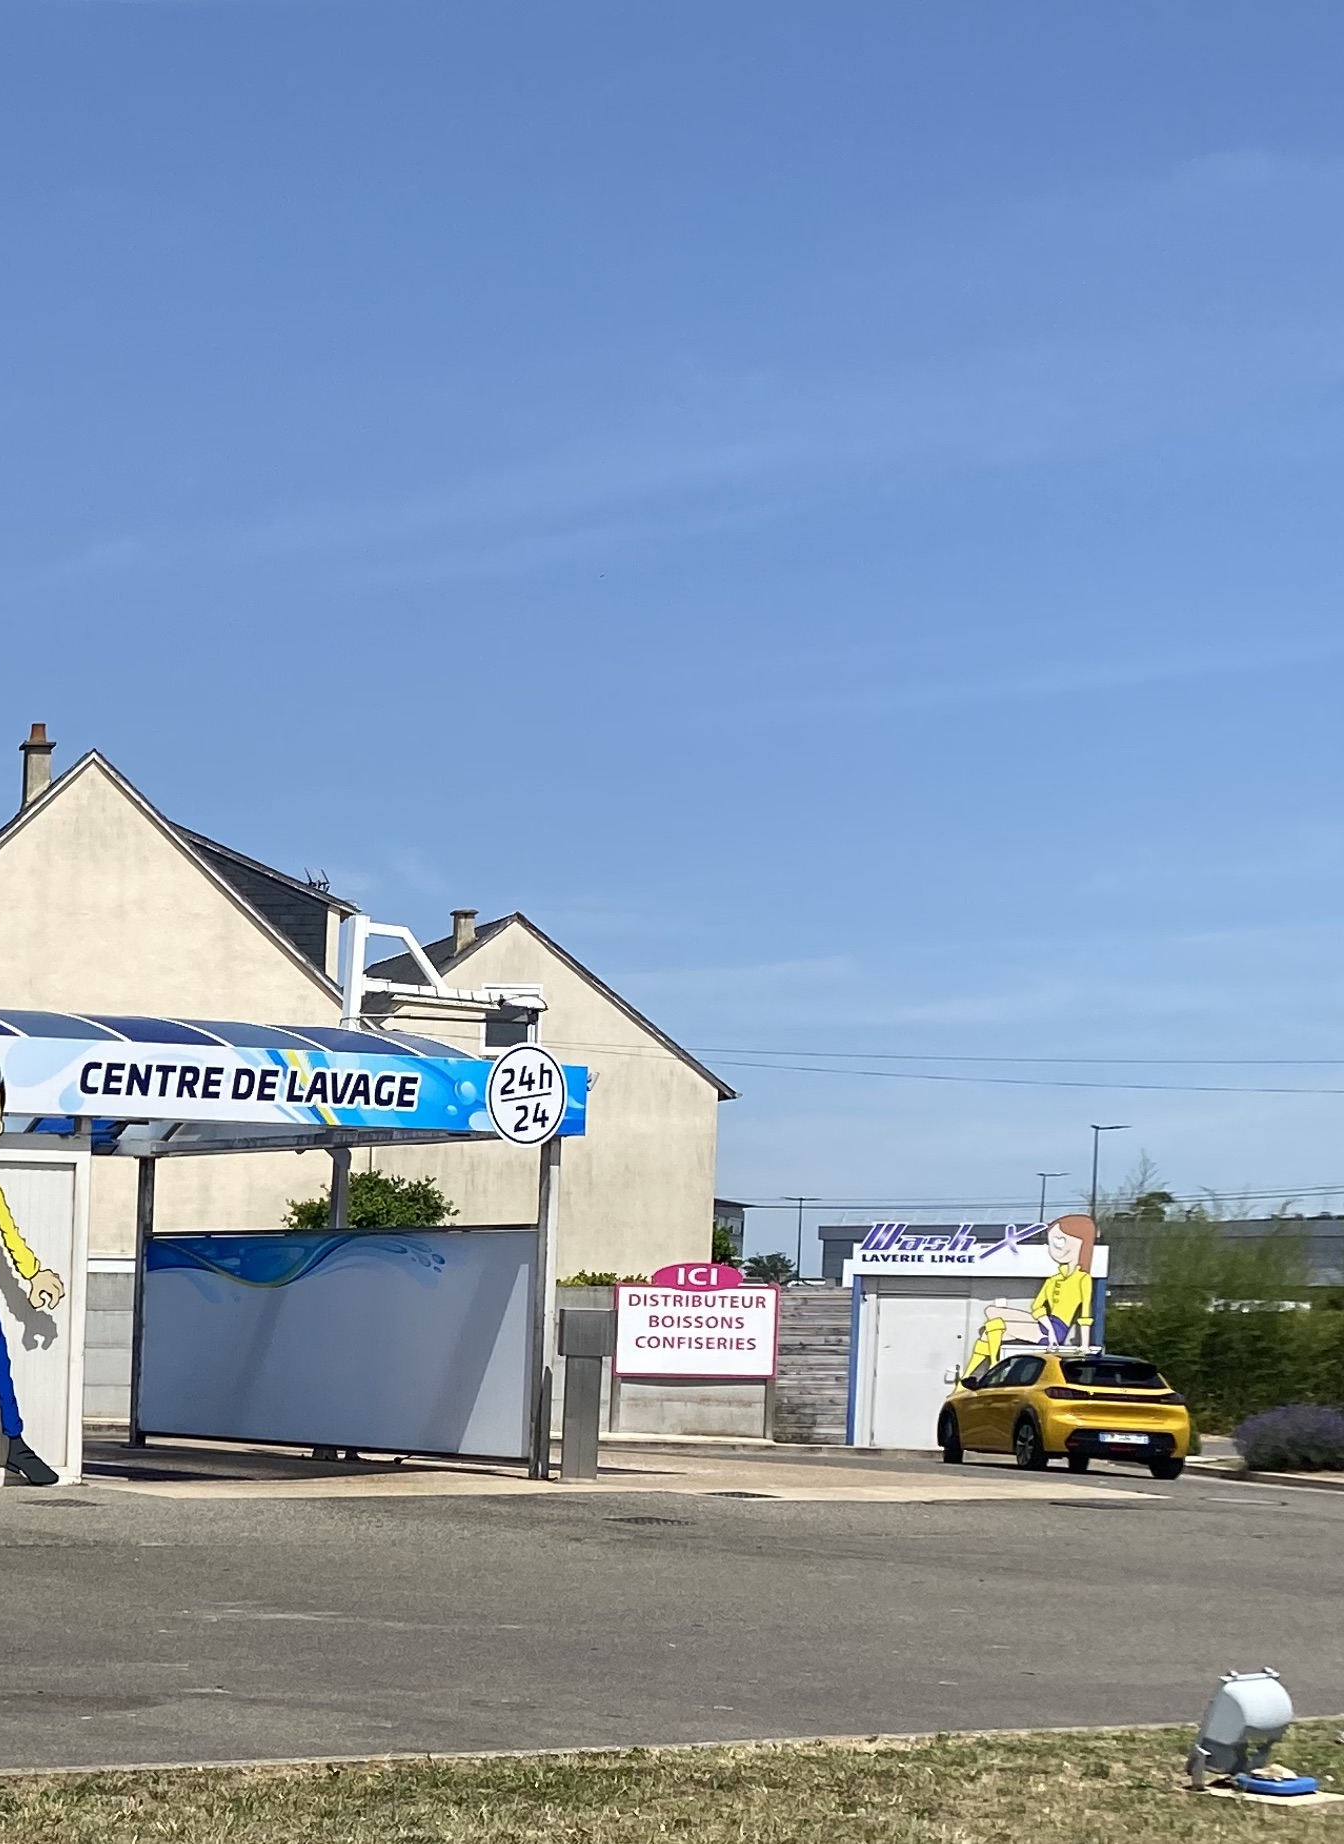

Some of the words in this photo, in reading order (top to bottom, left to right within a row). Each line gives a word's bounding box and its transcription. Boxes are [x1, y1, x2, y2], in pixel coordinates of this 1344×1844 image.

[79, 1061, 224, 1100] CENTRE
[232, 1067, 279, 1102] DE
[286, 1070, 419, 1108] LAVAGE
[499, 1063, 553, 1096] 24h
[514, 1102, 549, 1133] 24
[861, 1253, 925, 1263] LAVERIE
[930, 1254, 976, 1264] LINGE
[676, 1267, 719, 1286] ICI
[628, 1293, 767, 1309] DISTRIBUTEUR
[648, 1315, 745, 1330] BOISSONS
[635, 1335, 757, 1351] CONFISERIES
